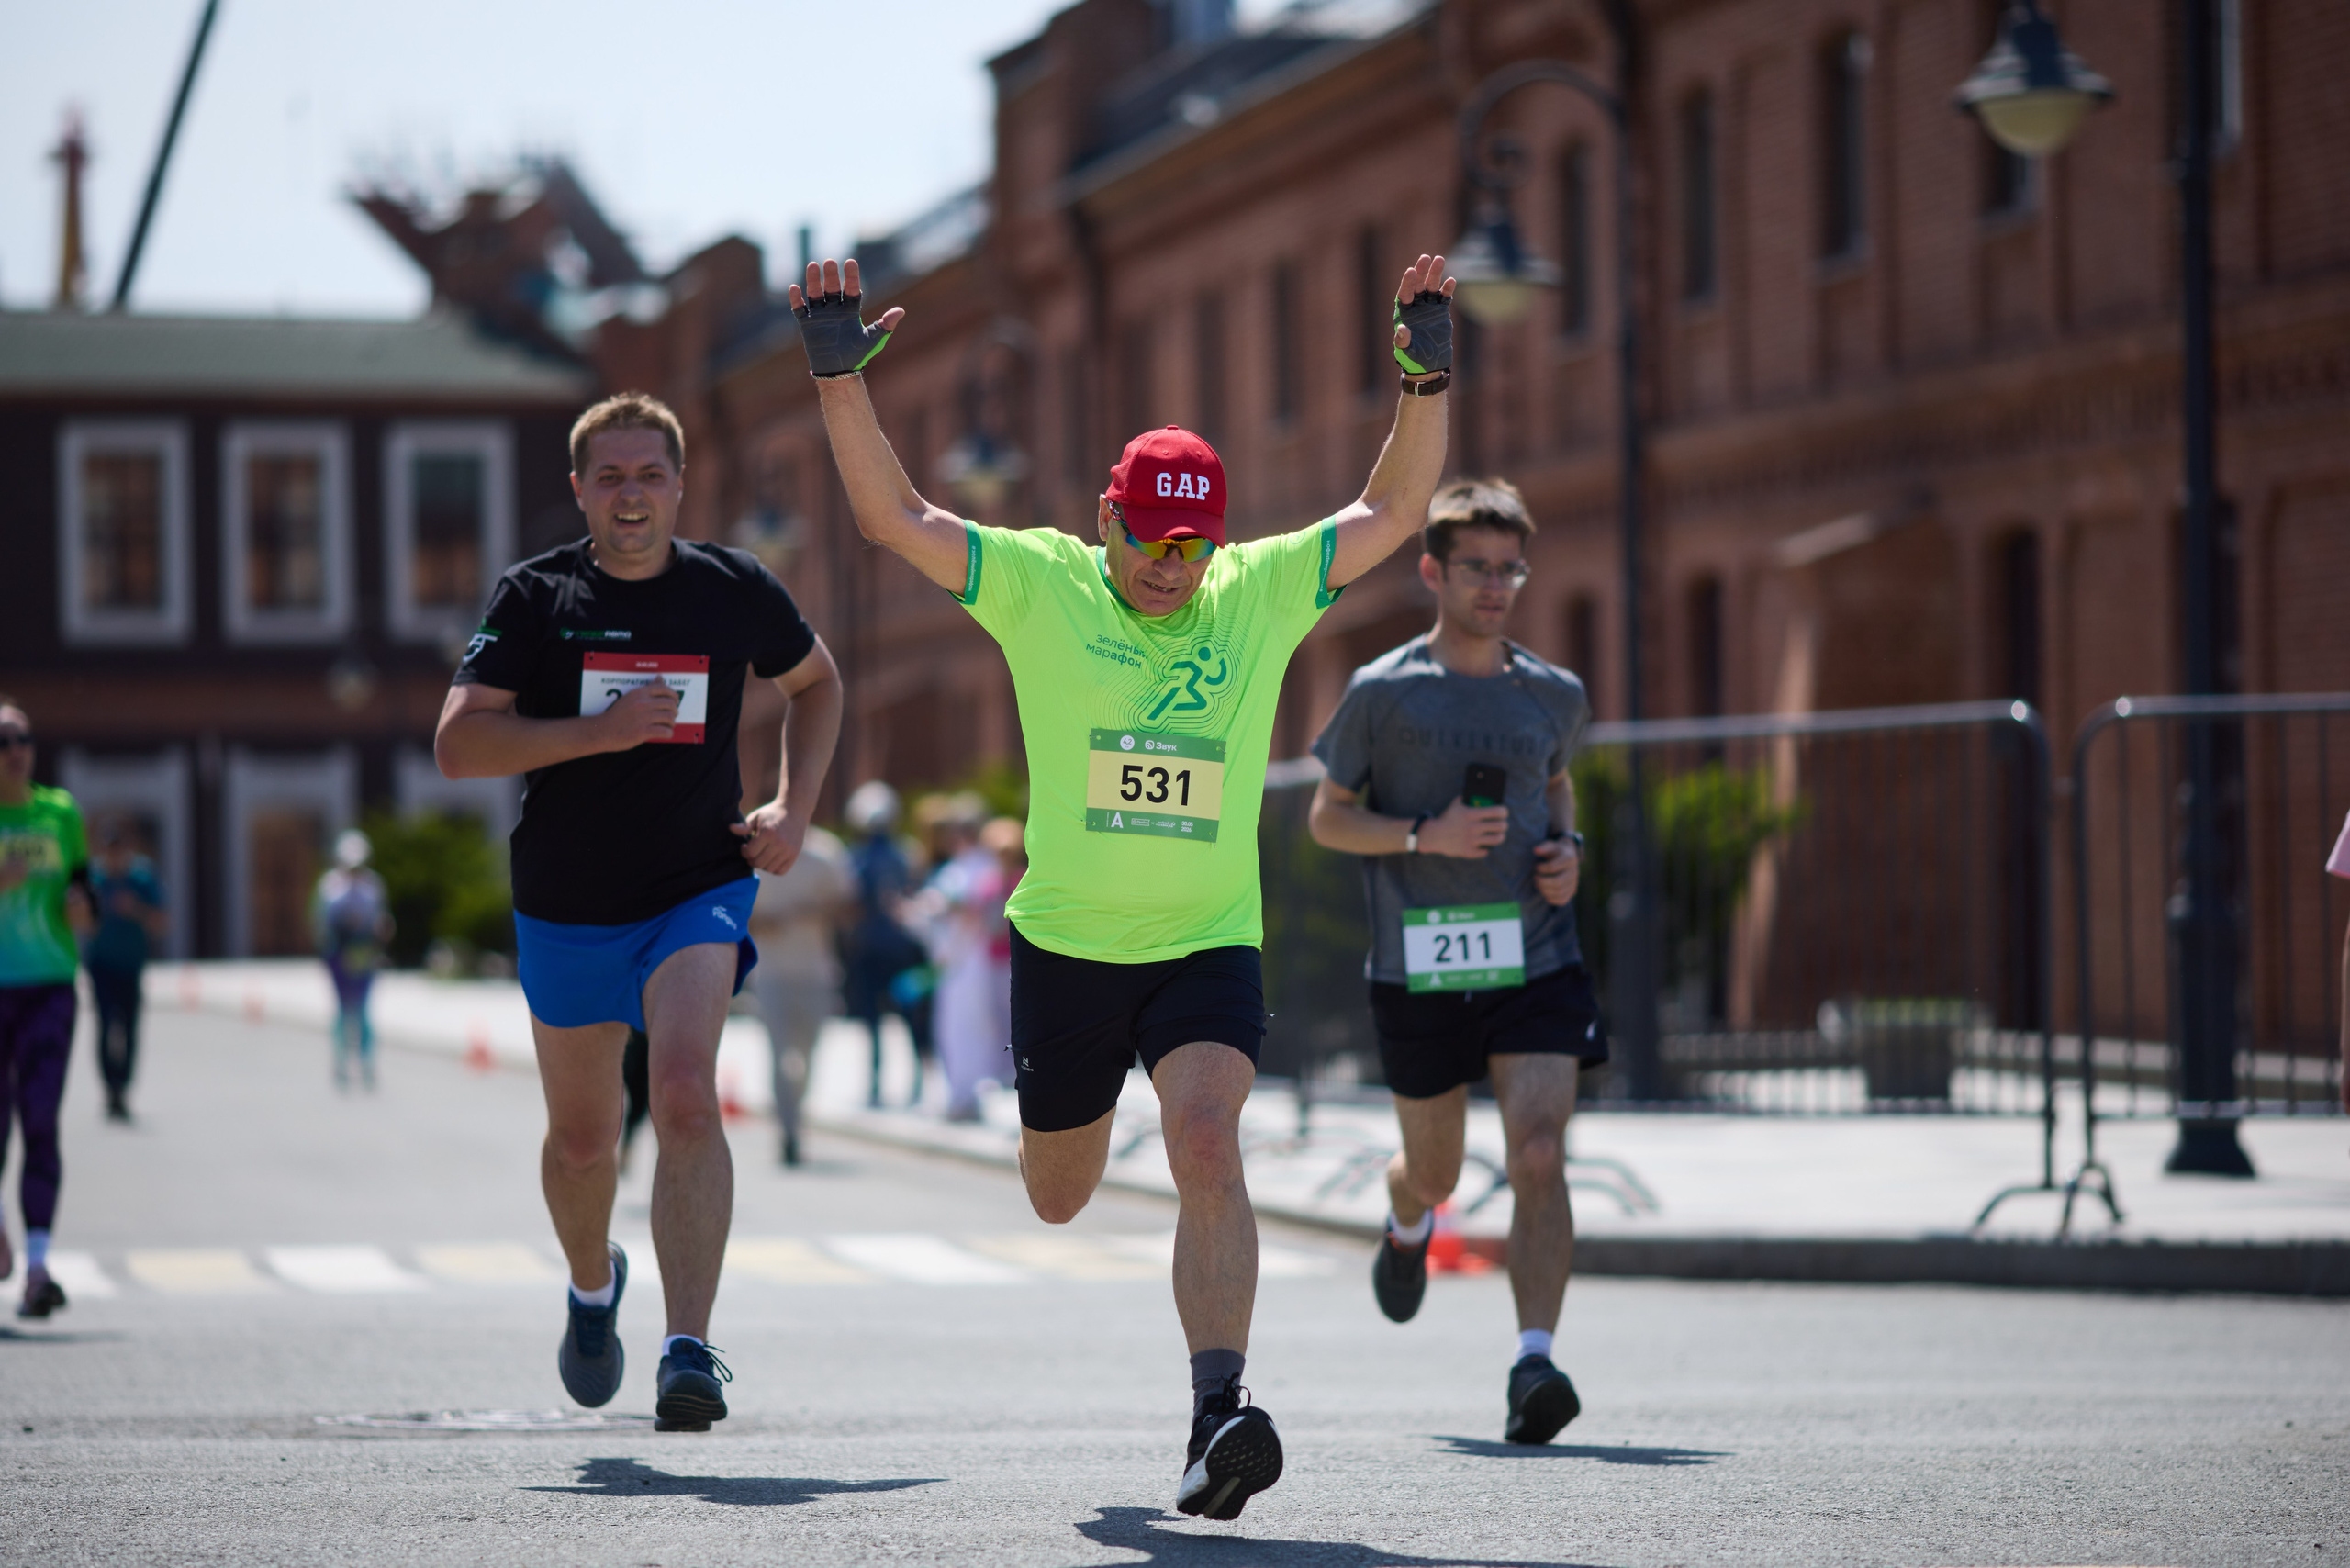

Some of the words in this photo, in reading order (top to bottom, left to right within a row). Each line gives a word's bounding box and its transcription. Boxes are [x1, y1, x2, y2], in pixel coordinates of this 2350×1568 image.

[1157, 472, 1210, 501] GAP
[1086, 643, 1142, 669] марафон
[1156, 742, 1177, 752] Звук
[1120, 764, 1191, 806] 531
[1433, 929, 1493, 964] 211
